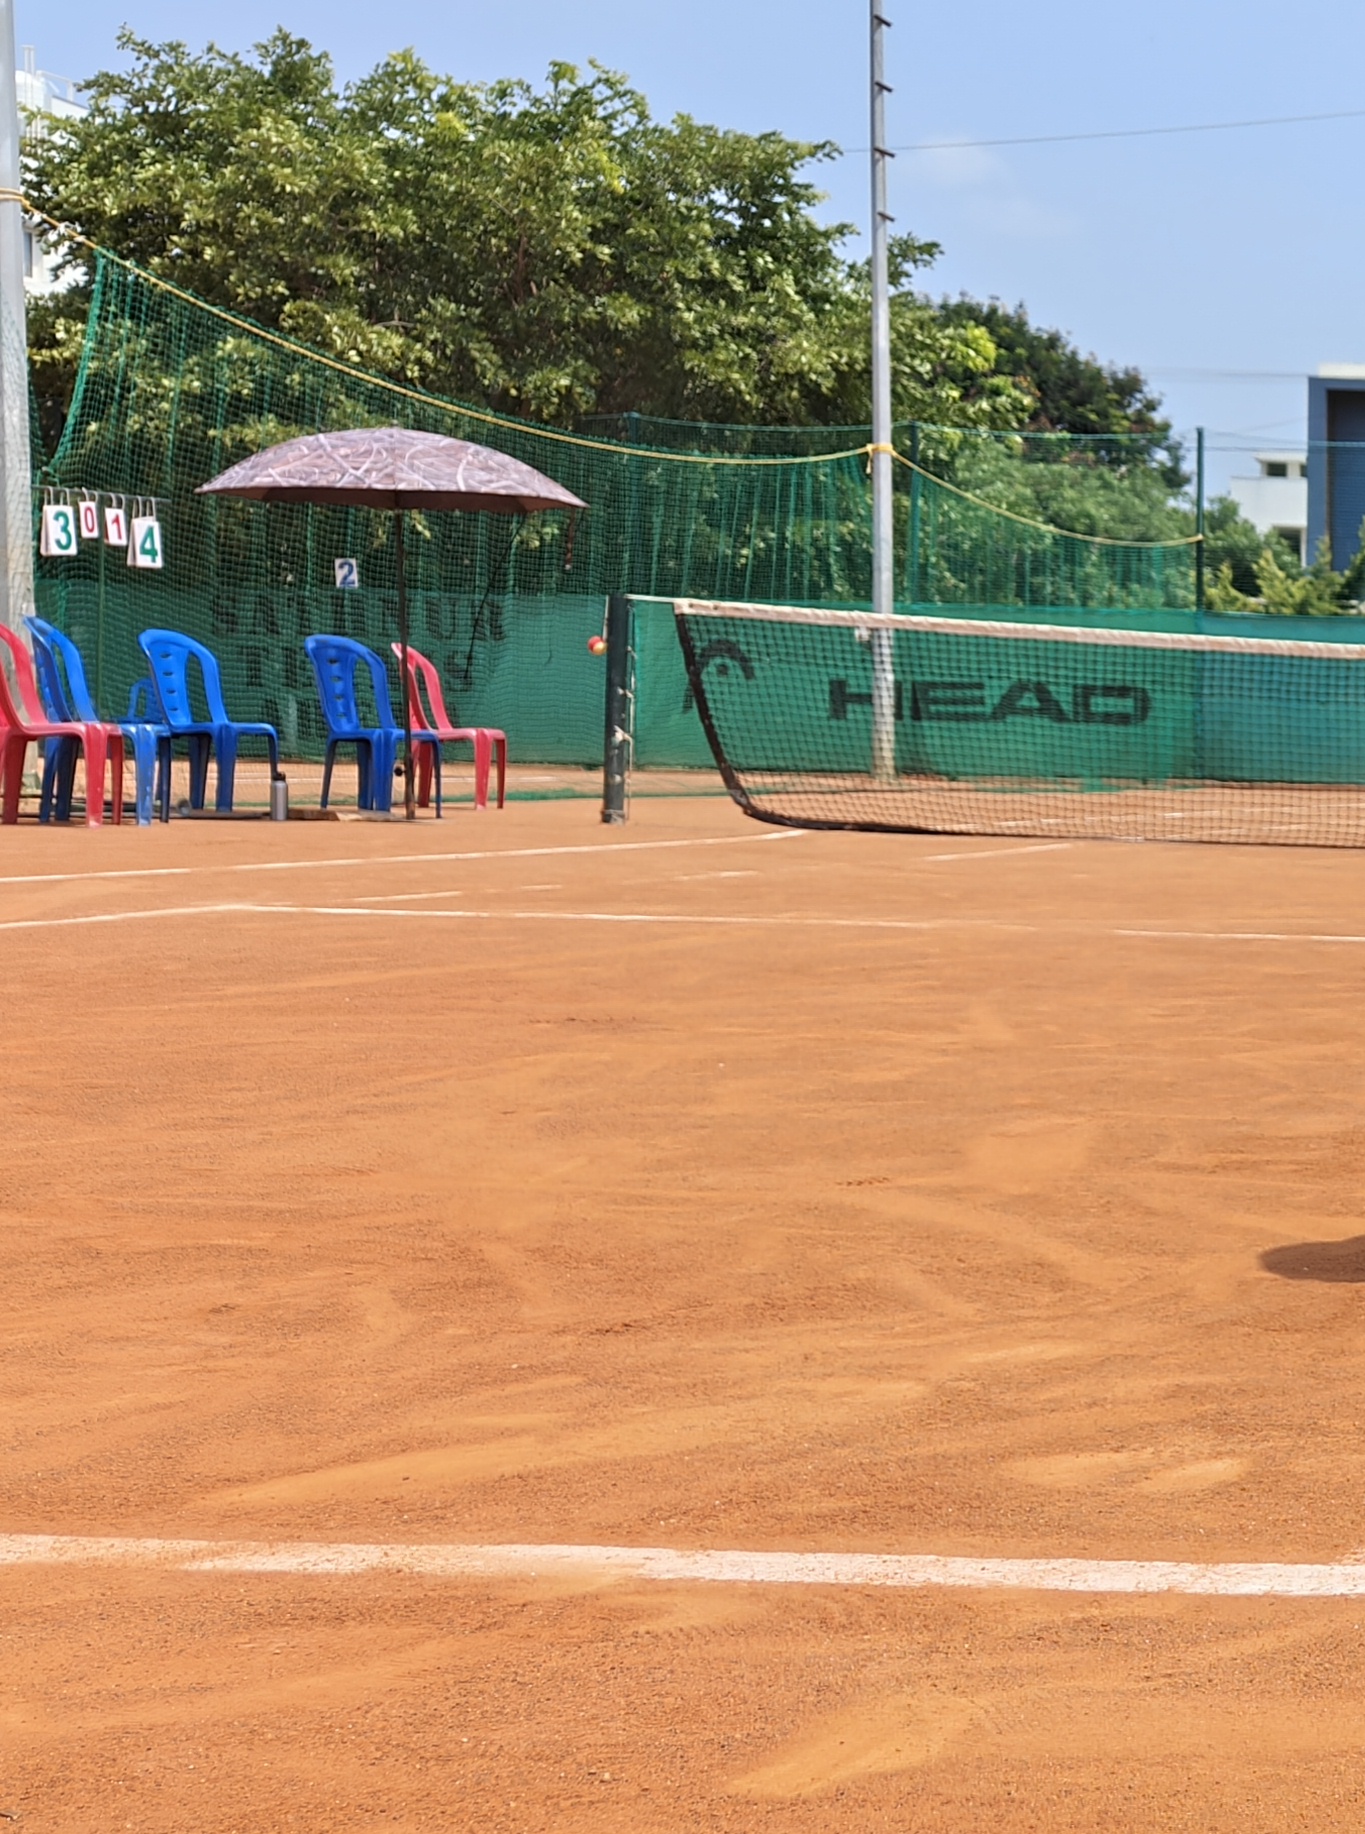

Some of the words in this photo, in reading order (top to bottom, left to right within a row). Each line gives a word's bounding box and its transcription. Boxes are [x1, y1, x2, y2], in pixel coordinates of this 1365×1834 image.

[53, 510, 72, 551] 3
[84, 506, 95, 533] 0
[112, 513, 122, 540] 1
[140, 525, 158, 563] 4
[338, 560, 356, 587] 2
[829, 679, 1151, 726] HEAD
